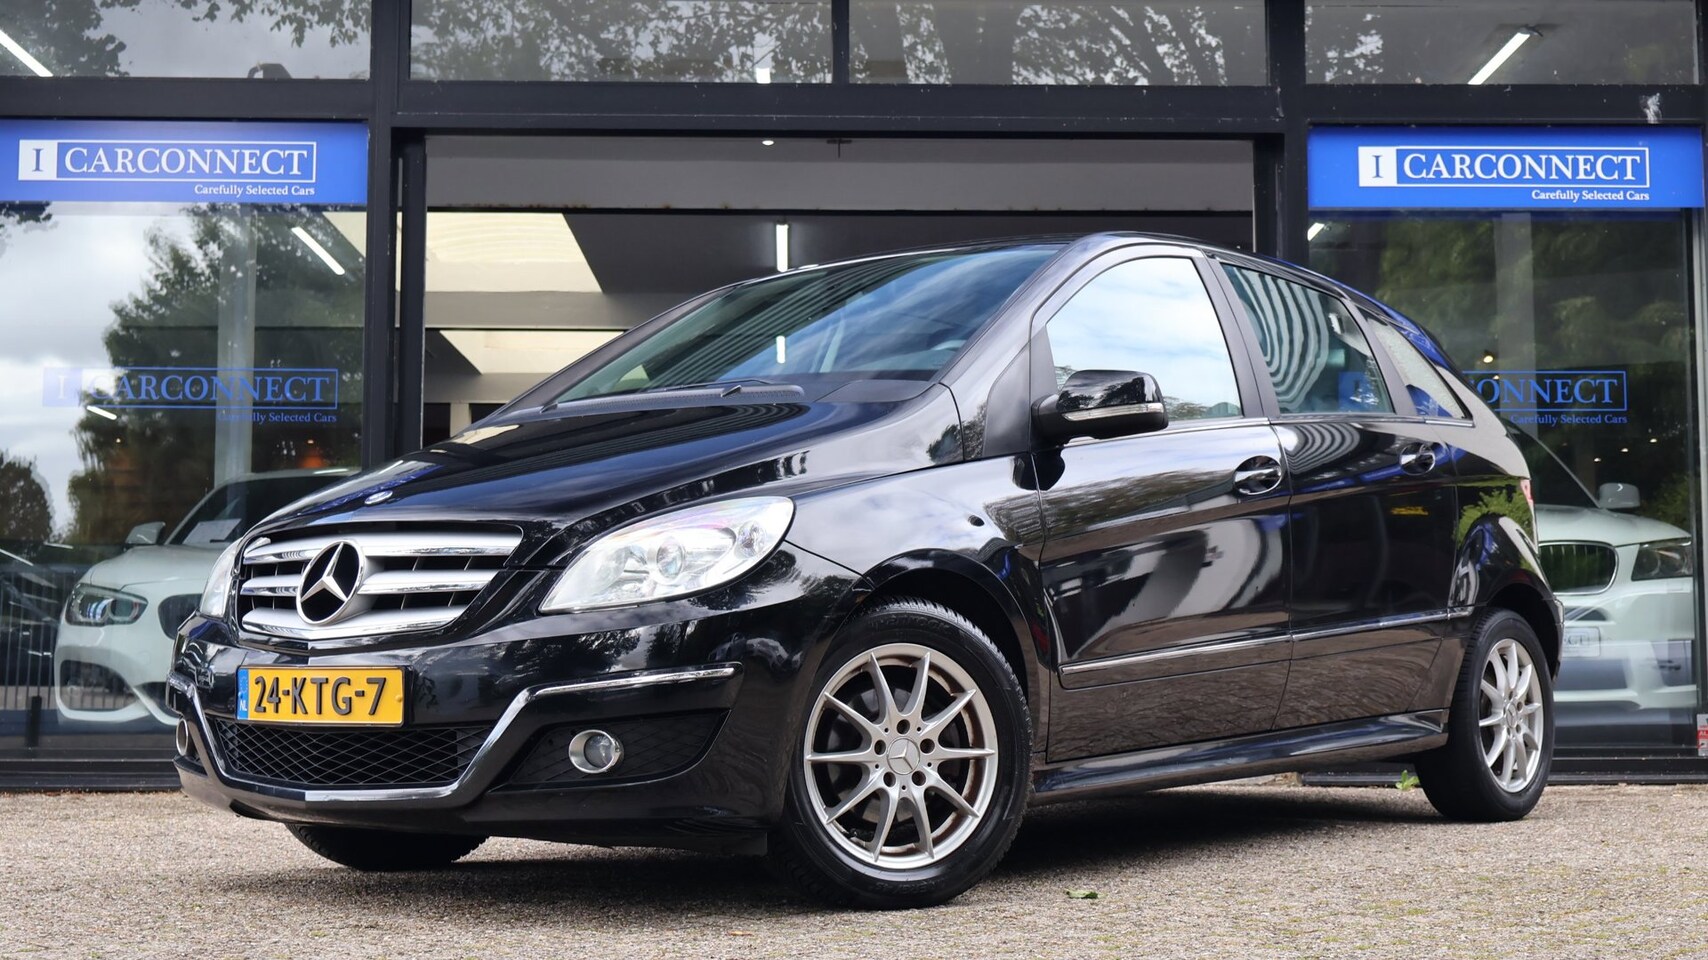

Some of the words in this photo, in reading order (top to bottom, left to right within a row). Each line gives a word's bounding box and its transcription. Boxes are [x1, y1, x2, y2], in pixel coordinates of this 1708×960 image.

[31, 148, 44, 172] I
[64, 147, 308, 175] CARCONNECT
[1371, 155, 1383, 179] I
[1403, 153, 1641, 181] CARCONNECT
[194, 184, 244, 198] Carefully
[245, 185, 289, 196] Selected
[291, 185, 315, 196] Cars
[1531, 189, 1580, 203] Carefully
[1582, 190, 1624, 201] Selected
[1626, 190, 1650, 201] Cars
[89, 375, 330, 402] CARCONNECT
[1470, 378, 1618, 404] ONNECT
[269, 412, 311, 423] Selected
[314, 413, 337, 423] Cars
[1560, 414, 1601, 424] Selected
[1604, 414, 1628, 424] Cars
[254, 676, 386, 716] 24-KTG-7
[239, 701, 248, 712] NL
